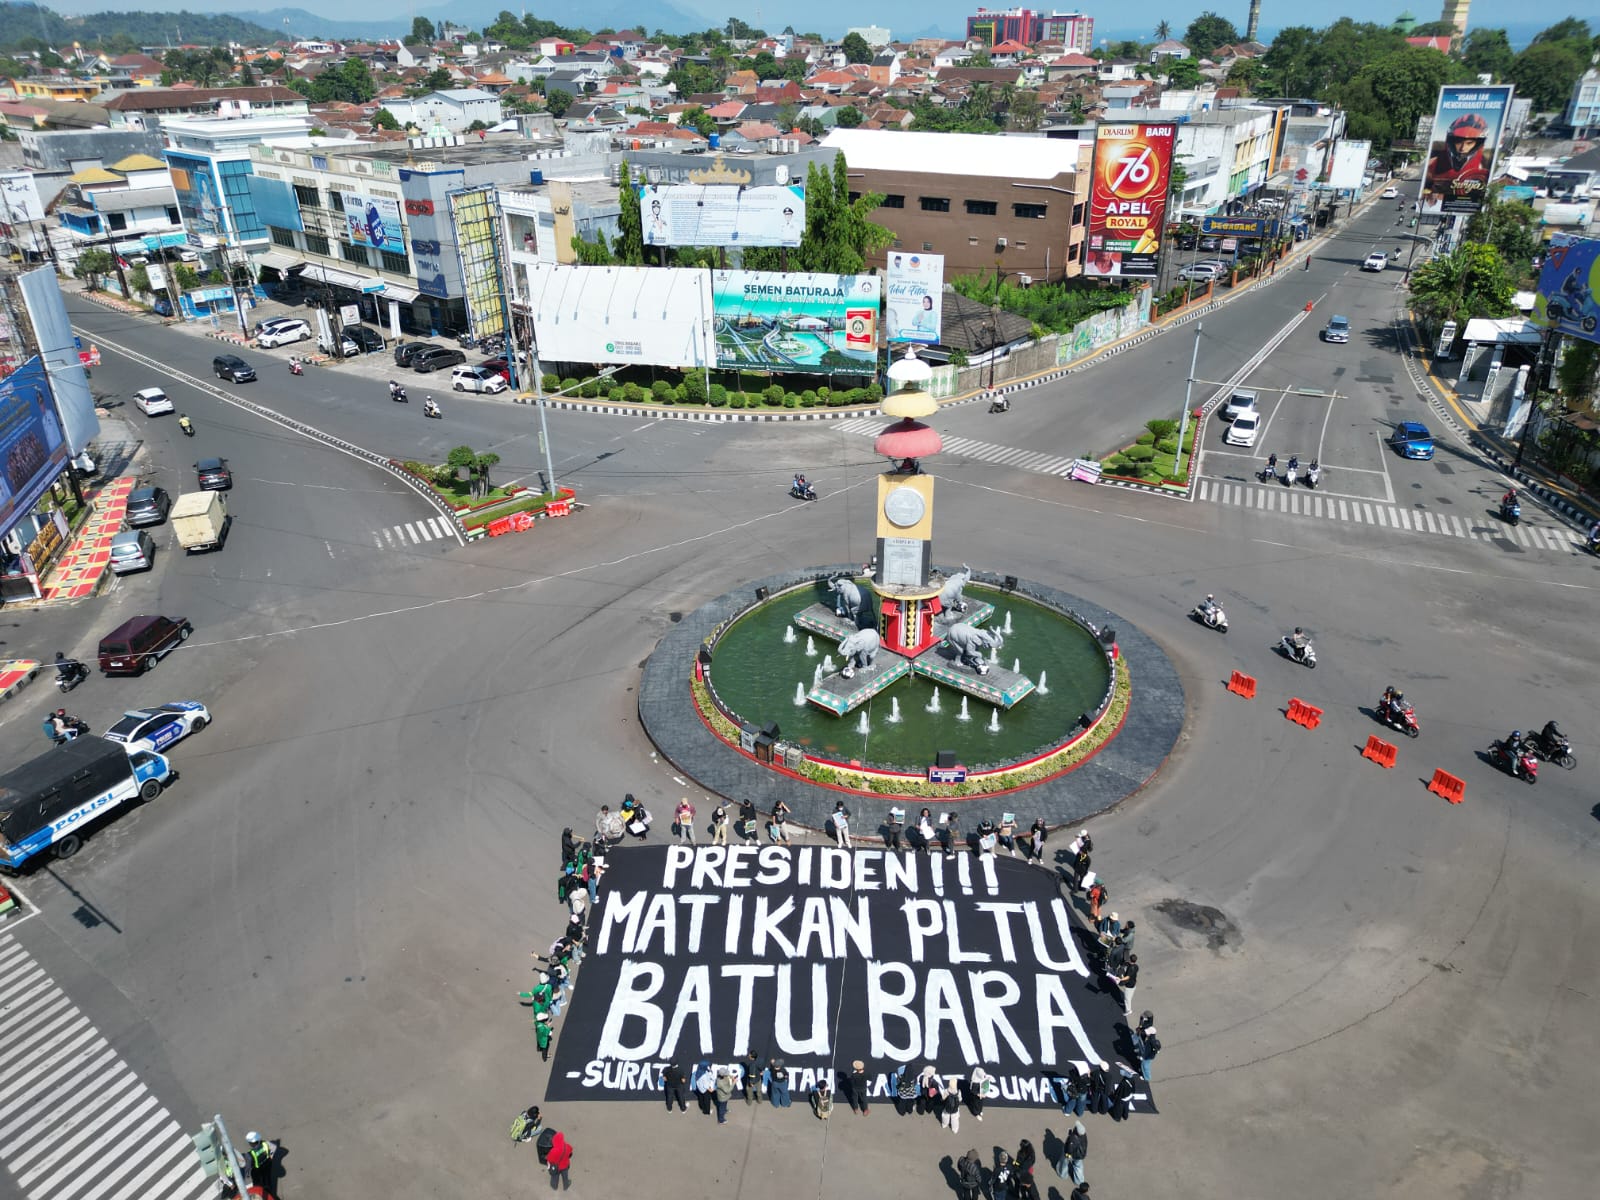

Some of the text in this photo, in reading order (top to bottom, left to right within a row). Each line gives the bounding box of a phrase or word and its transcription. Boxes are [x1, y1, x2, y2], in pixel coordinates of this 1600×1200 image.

[1146, 127, 1171, 137] BARU
[1111, 147, 1152, 192] 76
[1106, 202, 1151, 215] APEL
[1110, 217, 1145, 227] ROYAL
[744, 285, 844, 298] SEMEN BATURAJA
[55, 793, 113, 833] POLISI
[596, 890, 1090, 977] MATIKAN PLTU
[596, 959, 1101, 1065] BATU BARA
